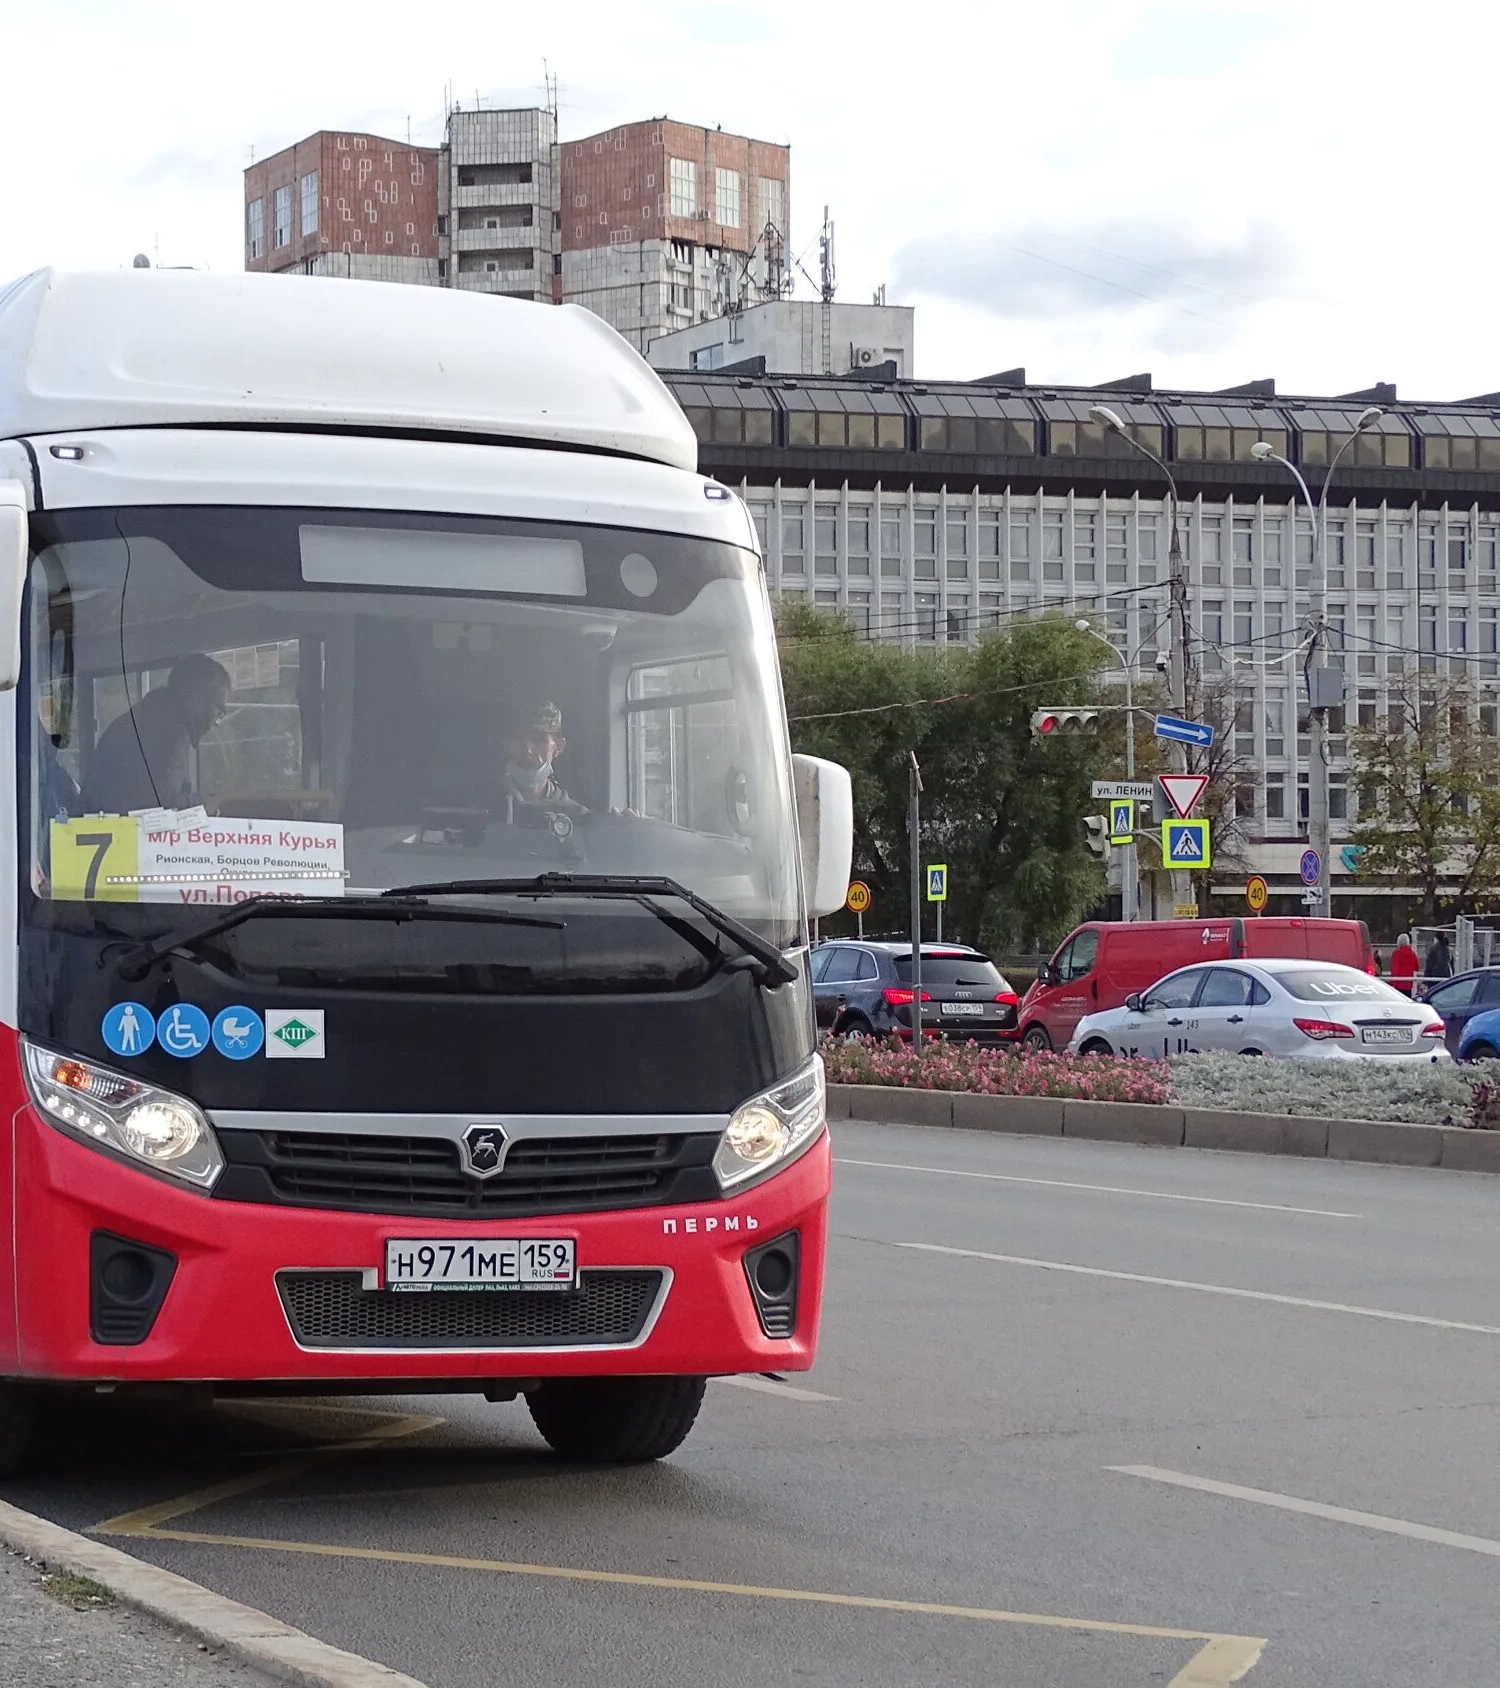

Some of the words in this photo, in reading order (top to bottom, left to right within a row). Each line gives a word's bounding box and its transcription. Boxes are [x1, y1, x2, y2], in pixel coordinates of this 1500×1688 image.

[1097, 787, 1112, 796] ул.
[1115, 785, 1152, 796] ЛЕНИН
[147, 830, 181, 847] м/р
[187, 827, 272, 847] Верхняя
[279, 831, 337, 851] Курья
[75, 832, 113, 900] 7
[156, 854, 214, 865] Рионская,
[217, 855, 260, 868] Борцов
[263, 856, 331, 871] Революции,
[851, 890, 865, 903] 40
[1251, 887, 1263, 901] 40
[1310, 981, 1380, 996] Uber
[281, 1027, 309, 1040] КПГ
[662, 1214, 759, 1234] ПЕРМЬ
[397, 1245, 516, 1278] Н971МЕ
[523, 1243, 568, 1269] 159
[531, 1268, 553, 1279] RUS
